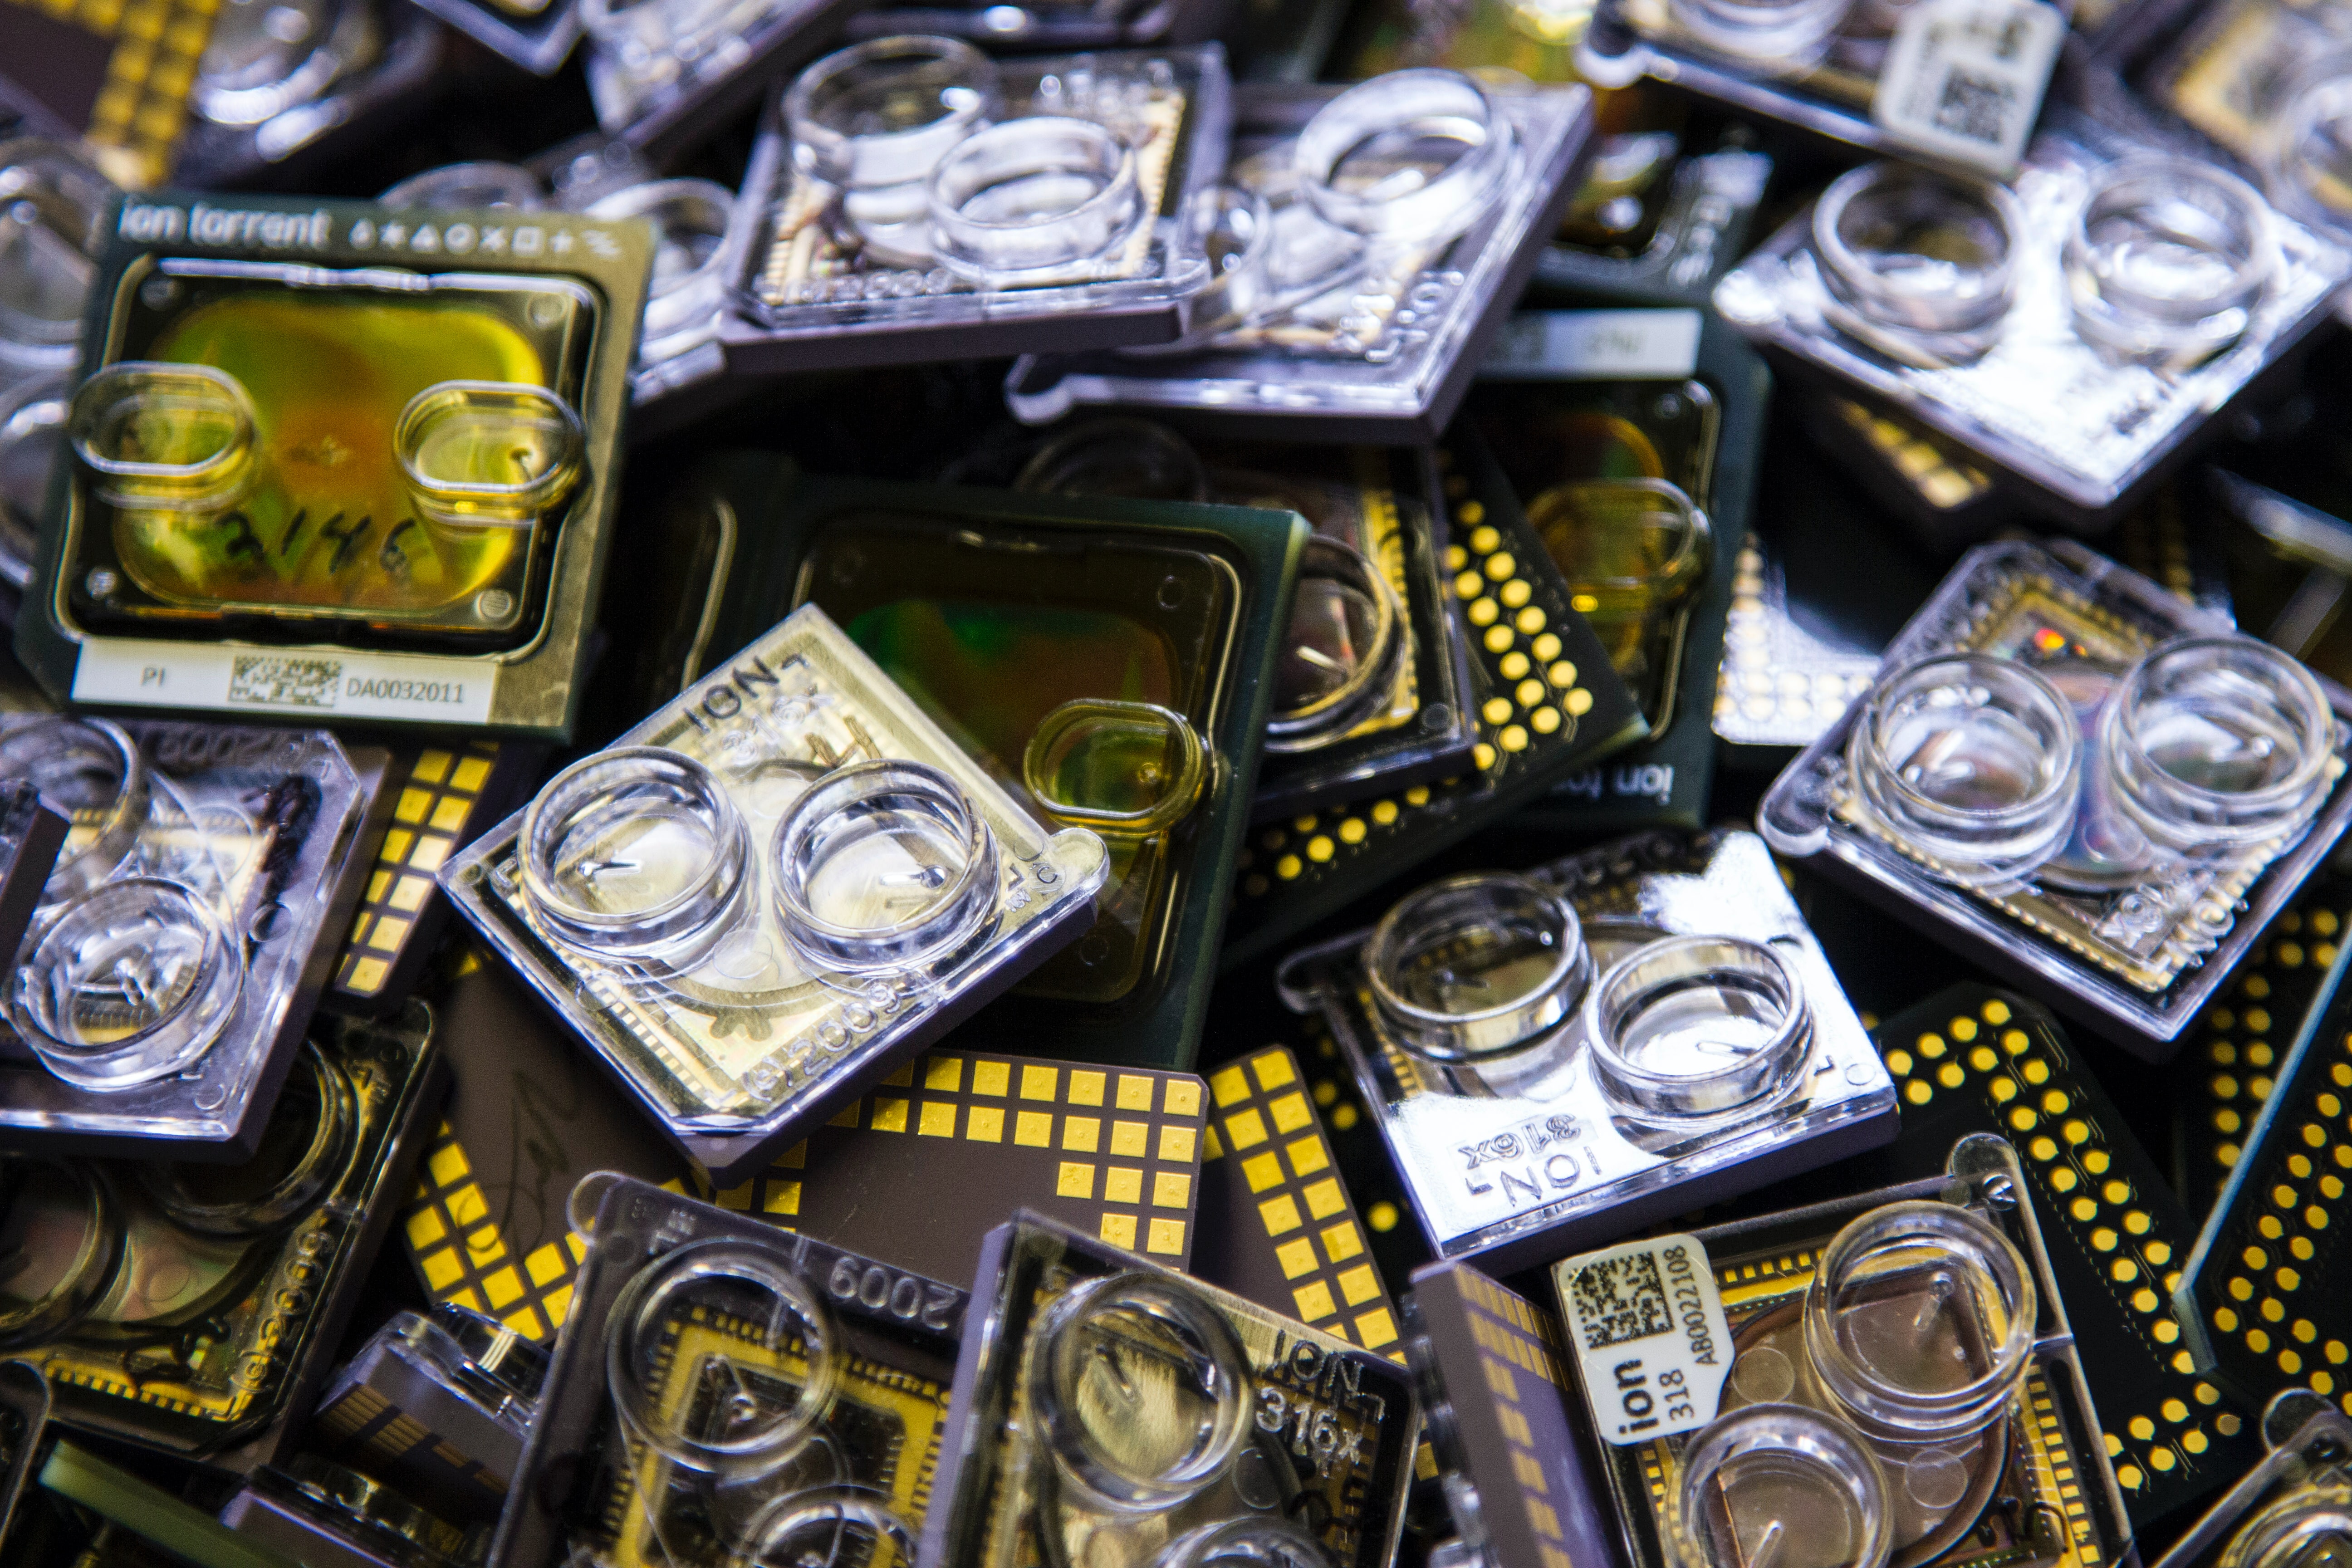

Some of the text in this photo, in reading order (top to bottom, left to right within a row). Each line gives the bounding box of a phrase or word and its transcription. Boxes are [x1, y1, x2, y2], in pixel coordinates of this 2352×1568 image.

[118, 194, 333, 250] ion torrent
[346, 676, 465, 704] DA0032011
[683, 653, 781, 734] ION
[1498, 1146, 1604, 1208] ION
[829, 1256, 960, 1330] 2009
[1662, 1244, 1719, 1366] AB0022108
[1618, 1358, 1659, 1436] ion
[1659, 1367, 1695, 1422] 318
